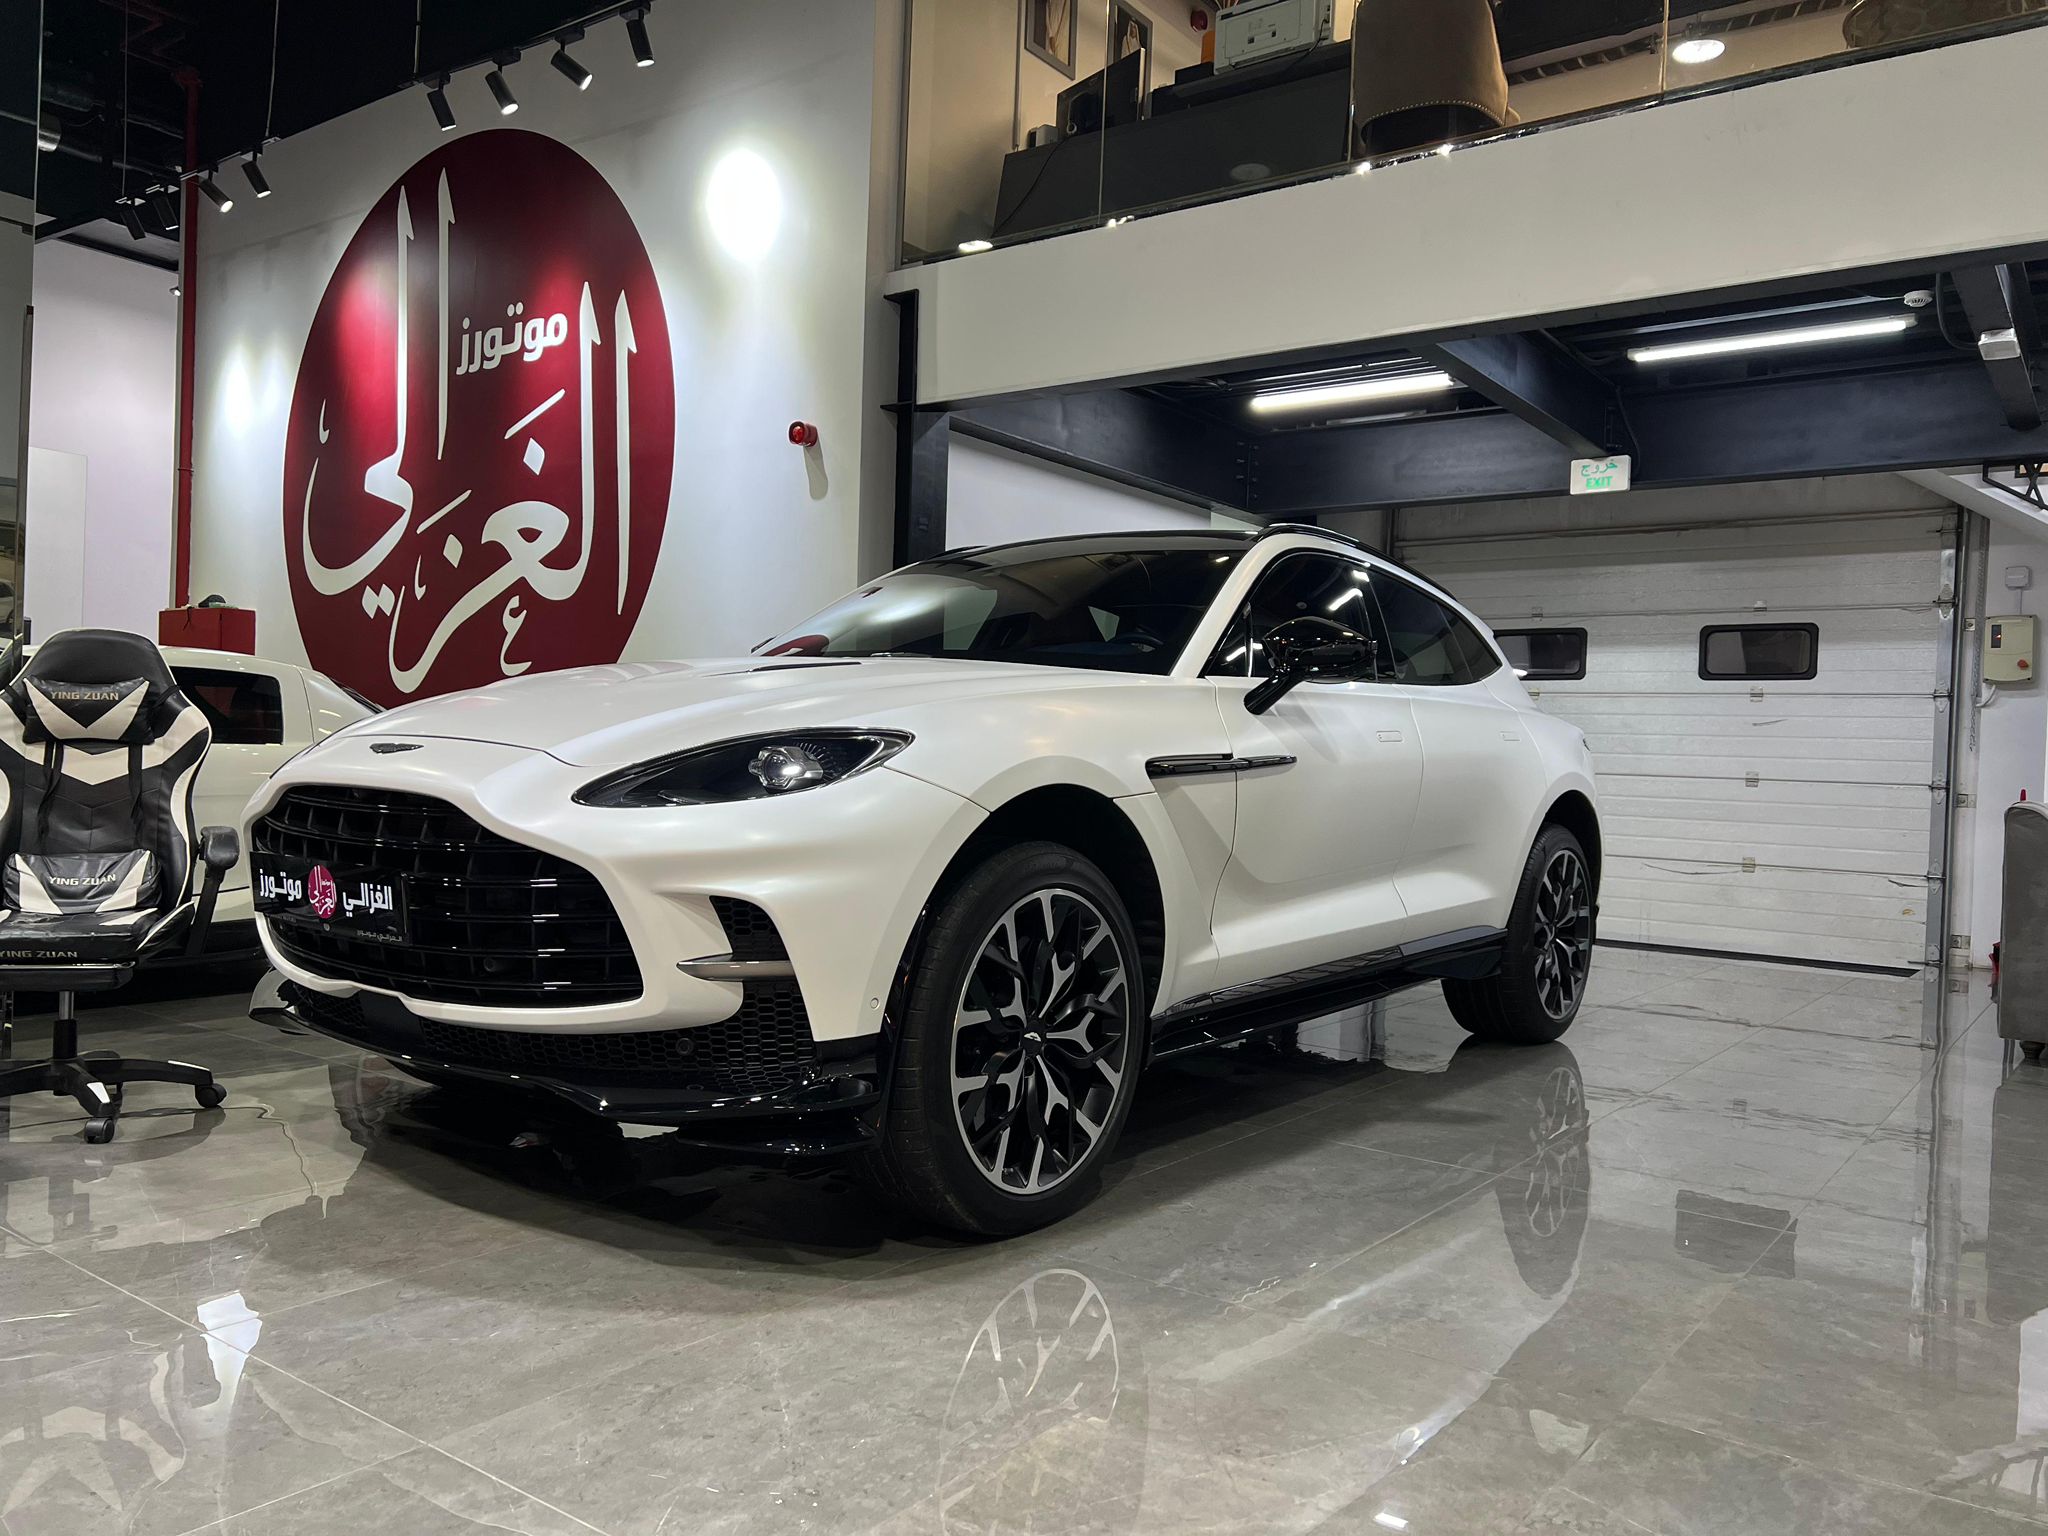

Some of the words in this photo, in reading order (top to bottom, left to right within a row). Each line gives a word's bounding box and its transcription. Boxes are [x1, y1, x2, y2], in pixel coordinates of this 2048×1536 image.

[456, 302, 568, 375] موتورز
[1581, 459, 1617, 476] خروج
[1586, 476, 1613, 489] EXIT
[51, 691, 80, 700] YING
[83, 691, 119, 700] ZUAN
[48, 876, 79, 885] YING
[82, 874, 116, 885] ZUAN
[259, 868, 302, 901] موتورز
[342, 882, 393, 918] الغزالي
